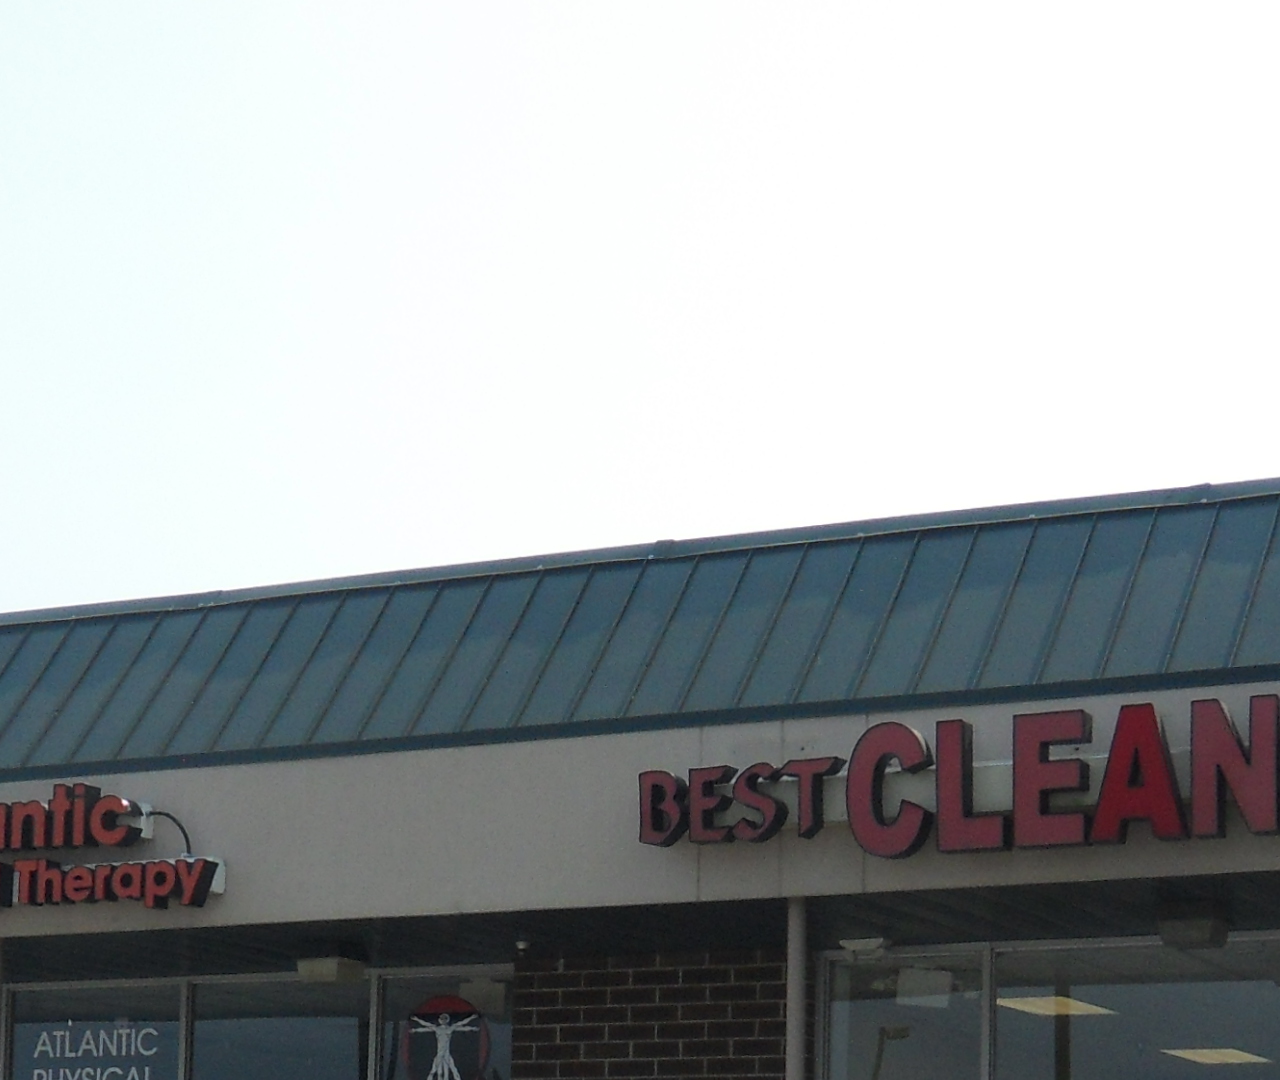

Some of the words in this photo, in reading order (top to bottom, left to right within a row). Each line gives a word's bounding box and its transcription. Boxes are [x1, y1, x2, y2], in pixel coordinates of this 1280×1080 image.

[638, 757, 843, 847] BEST
[15, 858, 219, 909] Therapy
[33, 1027, 159, 1059] ATLANTIC
